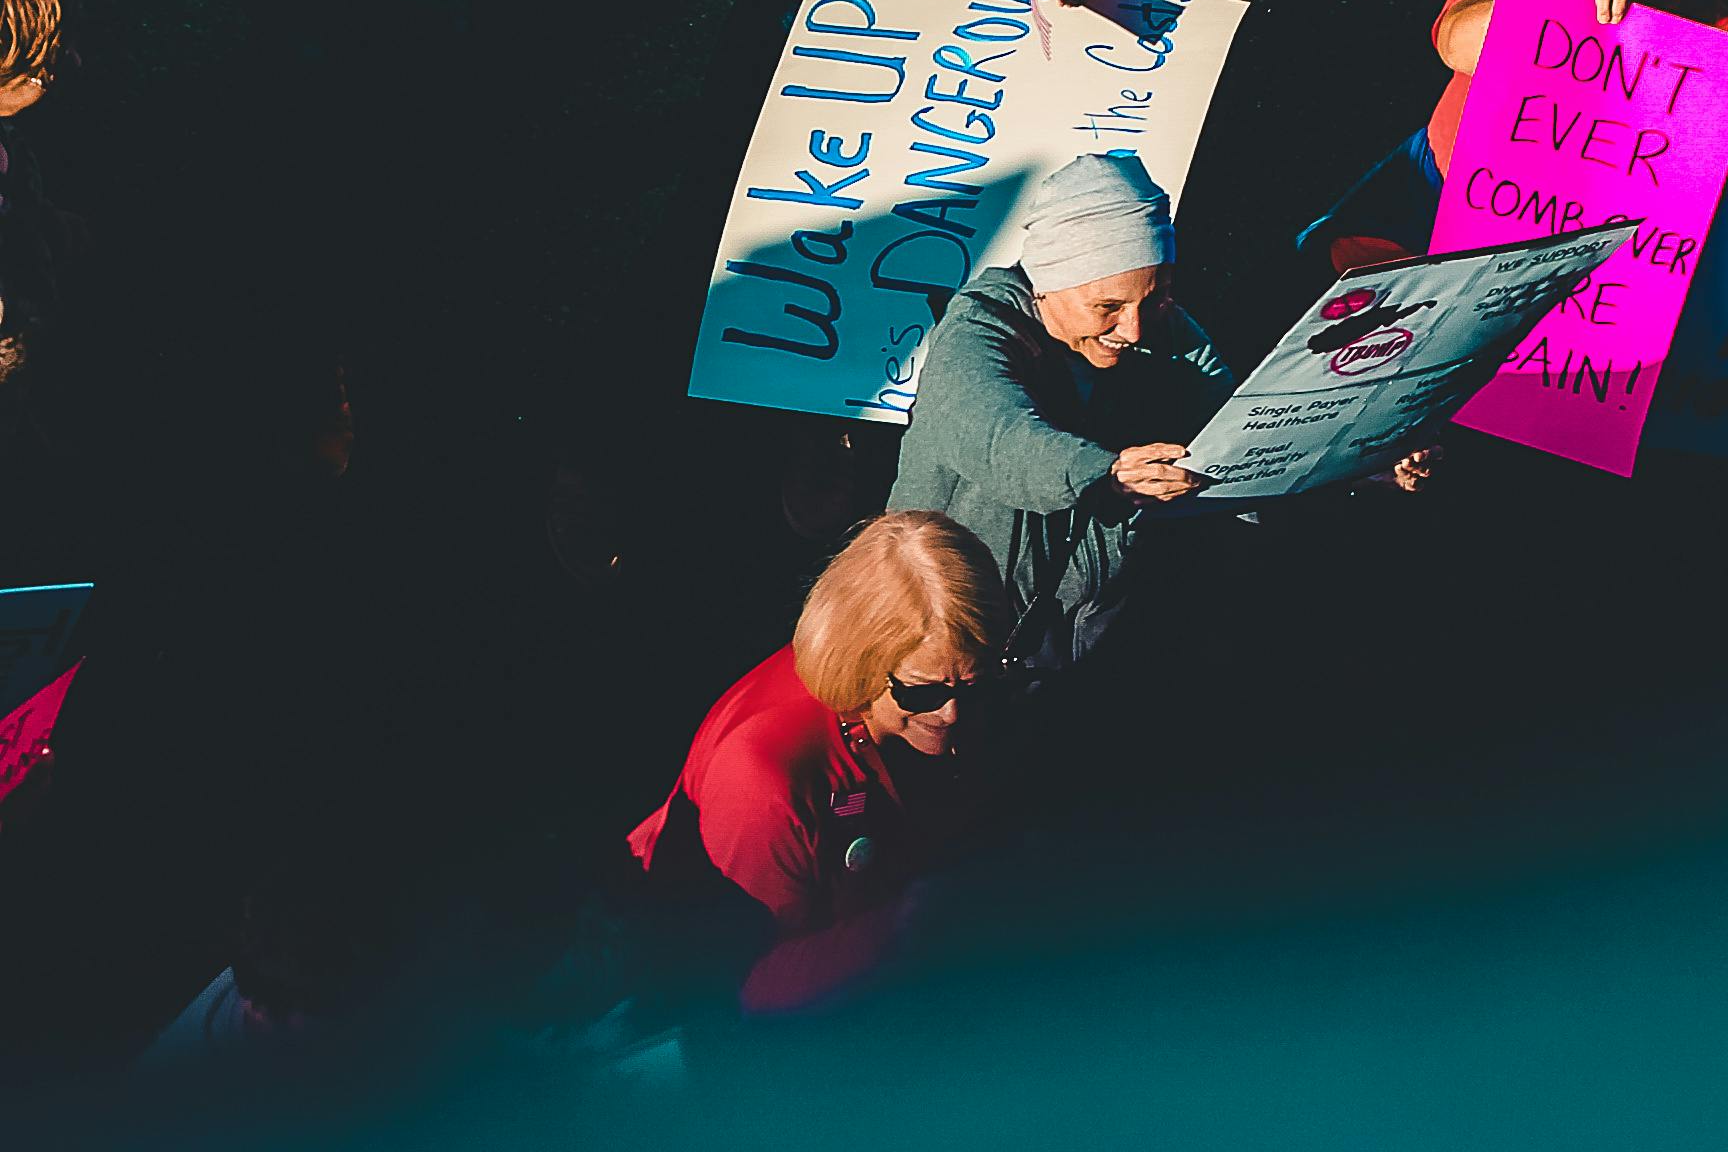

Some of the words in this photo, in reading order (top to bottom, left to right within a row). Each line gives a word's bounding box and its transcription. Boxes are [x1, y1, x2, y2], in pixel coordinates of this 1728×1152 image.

[1533, 19, 1704, 116] DON'T
[1072, 89, 1153, 140] the
[1510, 94, 1671, 188] EVER
[1465, 167, 1585, 237] COMB
[1602, 214, 1698, 276] VER
[1495, 257, 1527, 274] WE
[1247, 404, 1303, 419] Single
[1307, 396, 1360, 412] Payer
[1242, 411, 1340, 431] Healthcare
[1243, 441, 1294, 459] Equal
[1204, 451, 1310, 477] Opportunity
